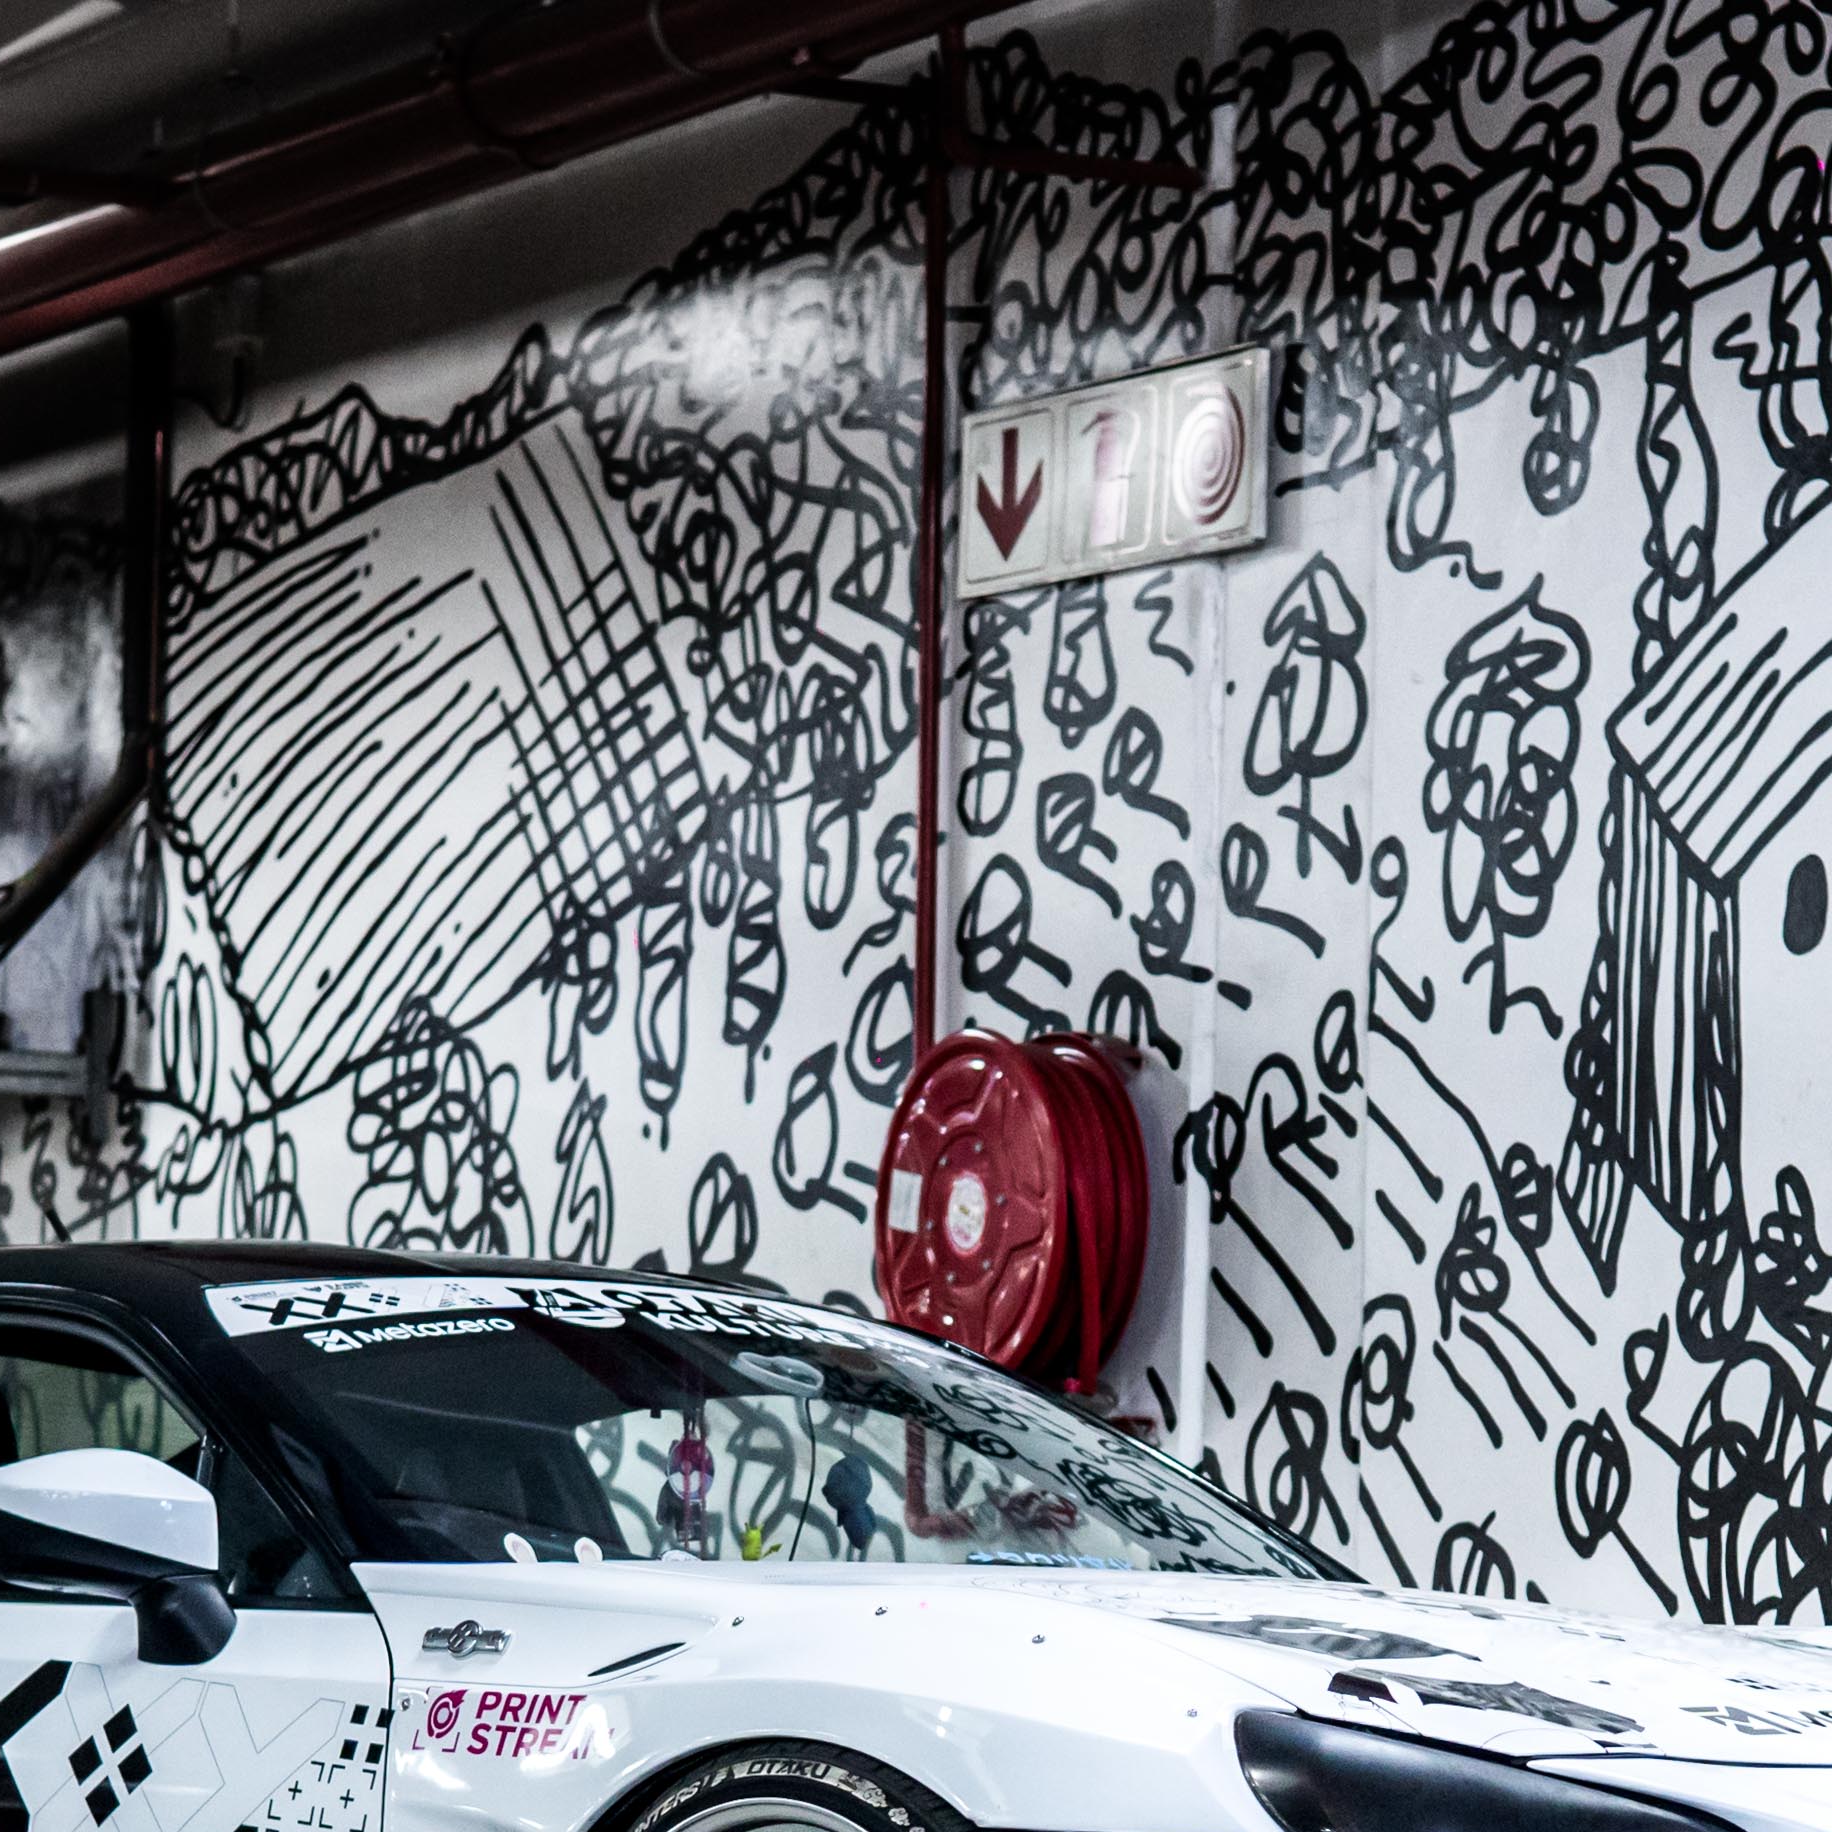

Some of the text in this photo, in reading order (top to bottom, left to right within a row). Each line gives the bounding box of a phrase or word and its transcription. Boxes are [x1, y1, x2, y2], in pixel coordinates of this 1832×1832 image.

[353, 1317, 515, 1344] Metazero
[639, 1311, 866, 1350] KULTURE
[475, 1691, 587, 1724] PRINT
[747, 1760, 831, 1779] OTAKU
